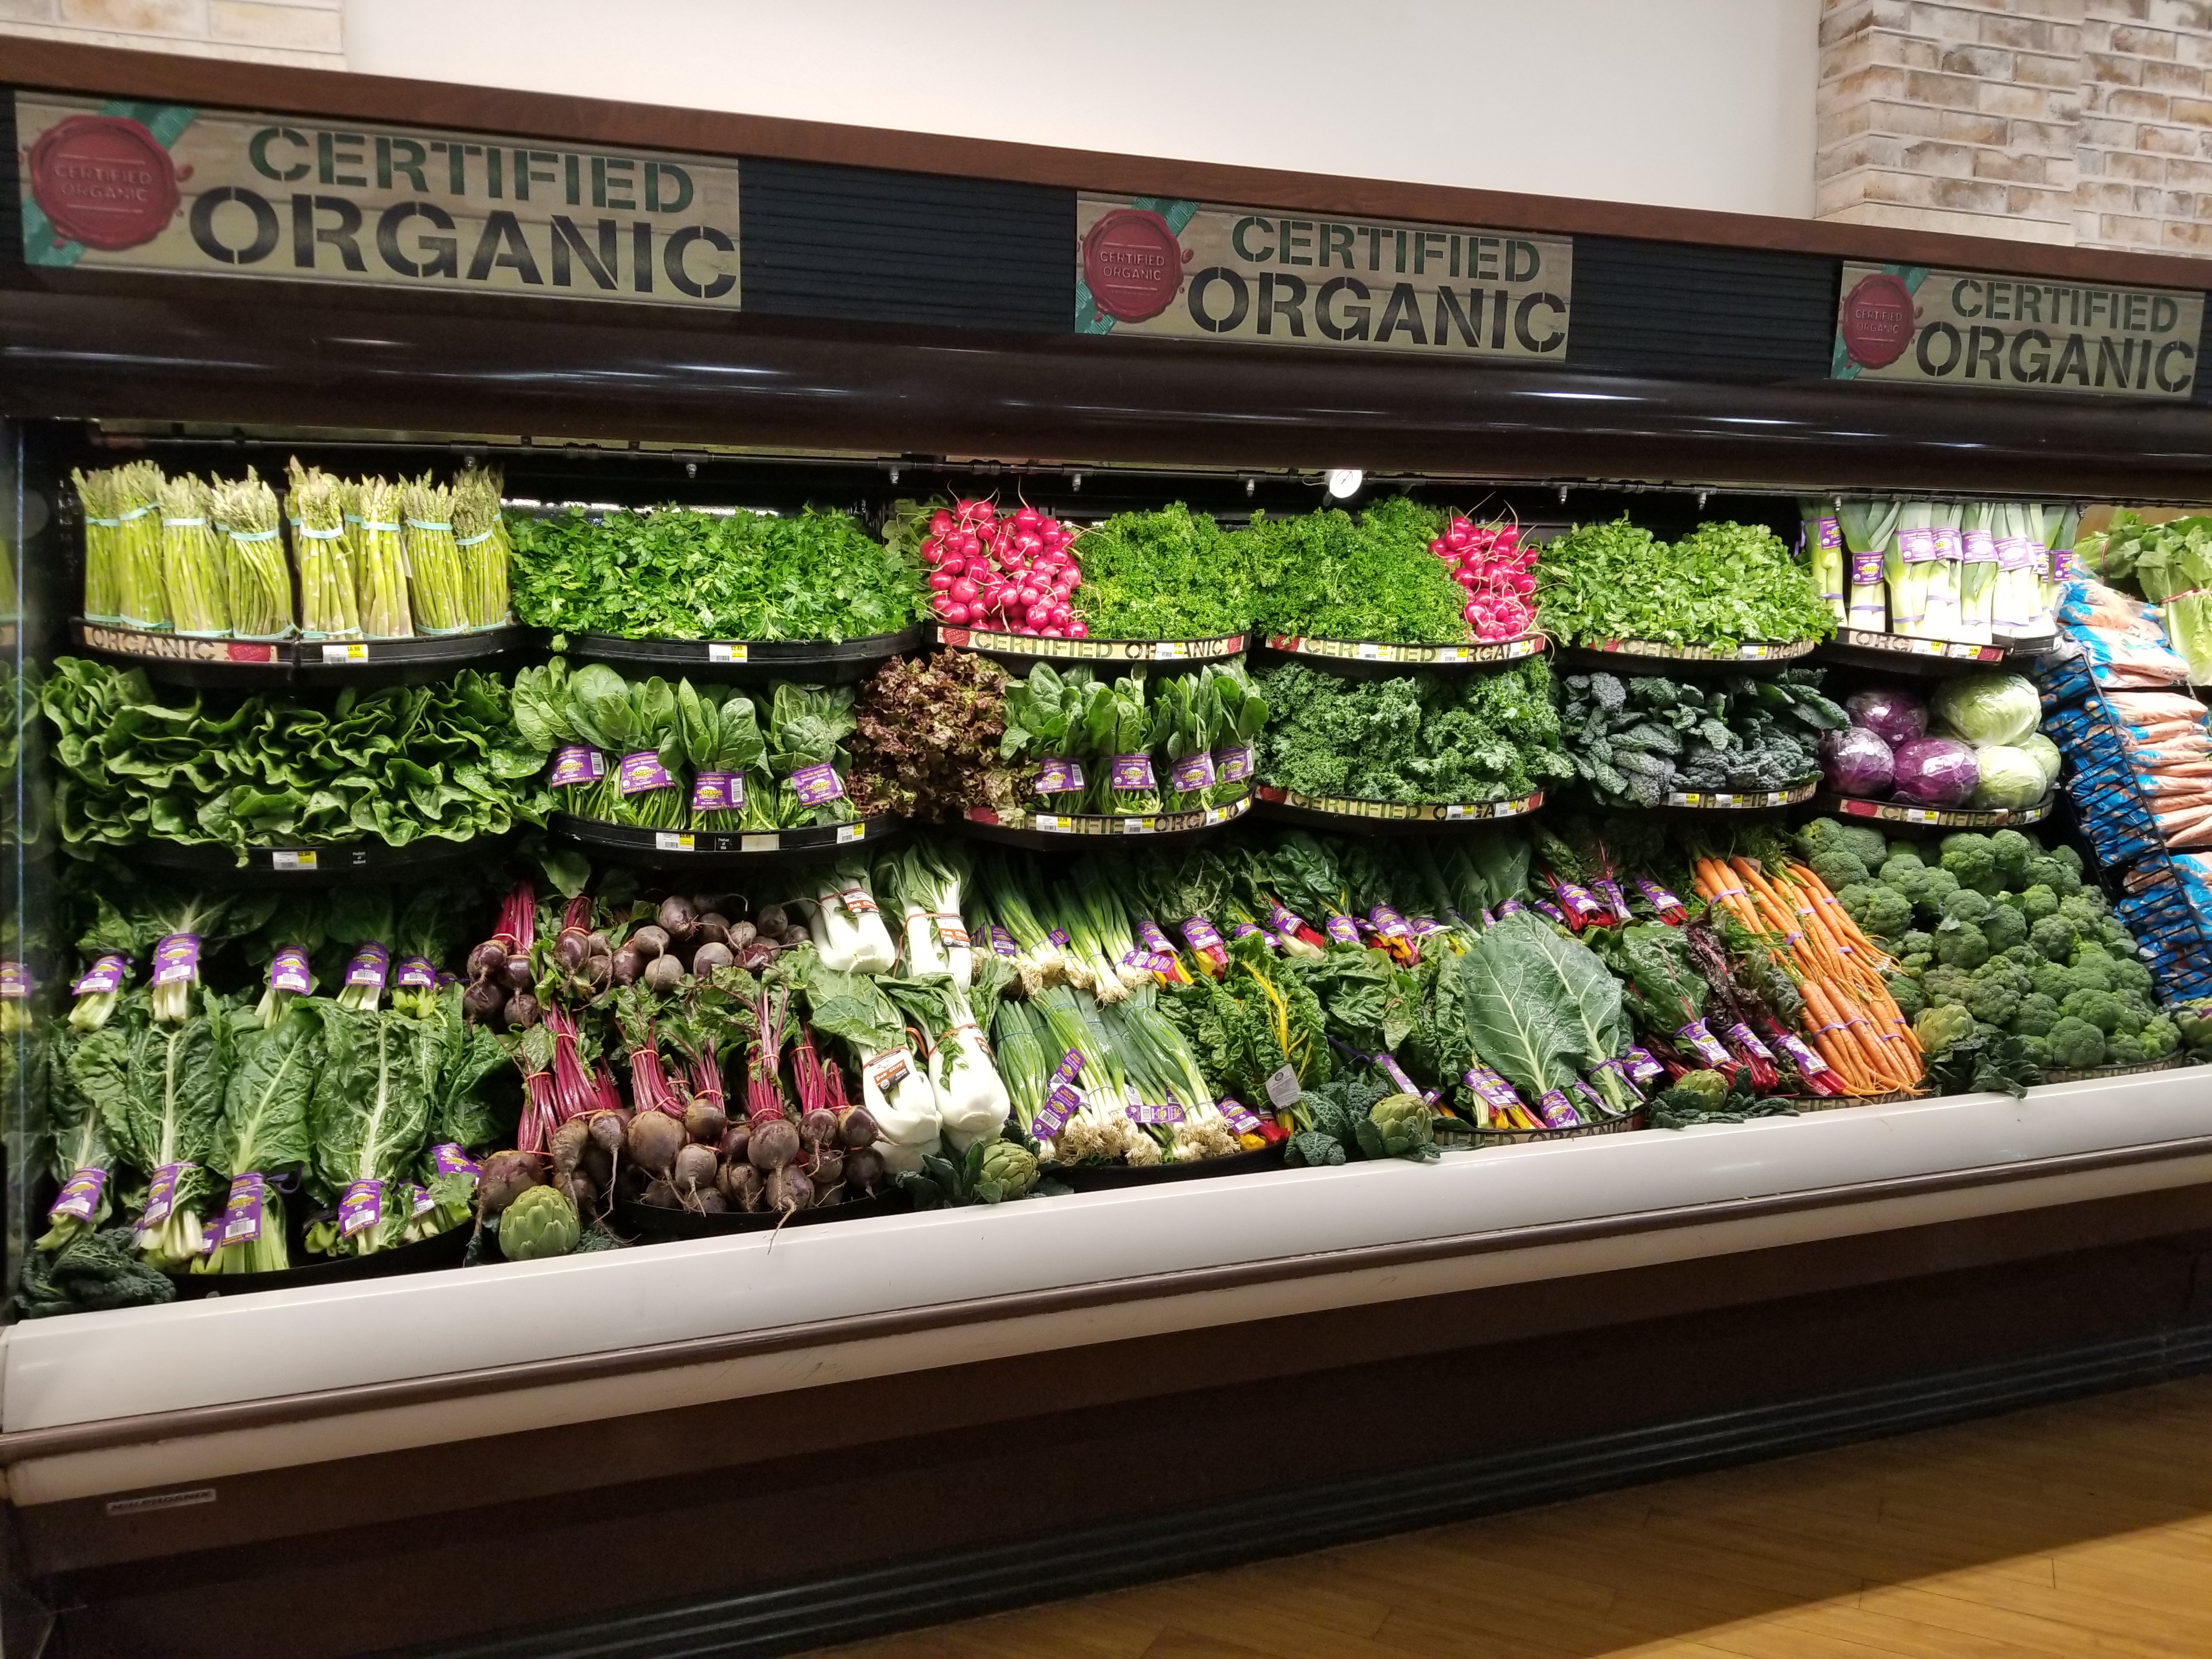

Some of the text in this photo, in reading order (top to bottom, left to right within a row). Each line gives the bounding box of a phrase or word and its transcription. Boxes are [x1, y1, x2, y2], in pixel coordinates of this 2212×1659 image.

[54, 163, 153, 185] CERTIFIED
[249, 126, 694, 214] CERTIFIED
[61, 182, 149, 204] ORGANIC
[189, 185, 737, 299] ORGANIC
[1232, 216, 1541, 283] CERTIFIED
[1099, 251, 1165, 267] CERTIFIED
[1103, 266, 1161, 281] ORGANIC
[1188, 266, 1567, 353] ORGANIC
[1855, 309, 1903, 321] CERTIFIED
[1951, 279, 2178, 333] CERTIFIED
[1857, 323, 1899, 334] ORGANIC
[1916, 321, 2195, 393] ORGANIC
[92, 629, 216, 659] ORGANIC
[974, 633, 1223, 659] CERTIFIED ORANIC
[889, 1061, 904, 1073] Choy
